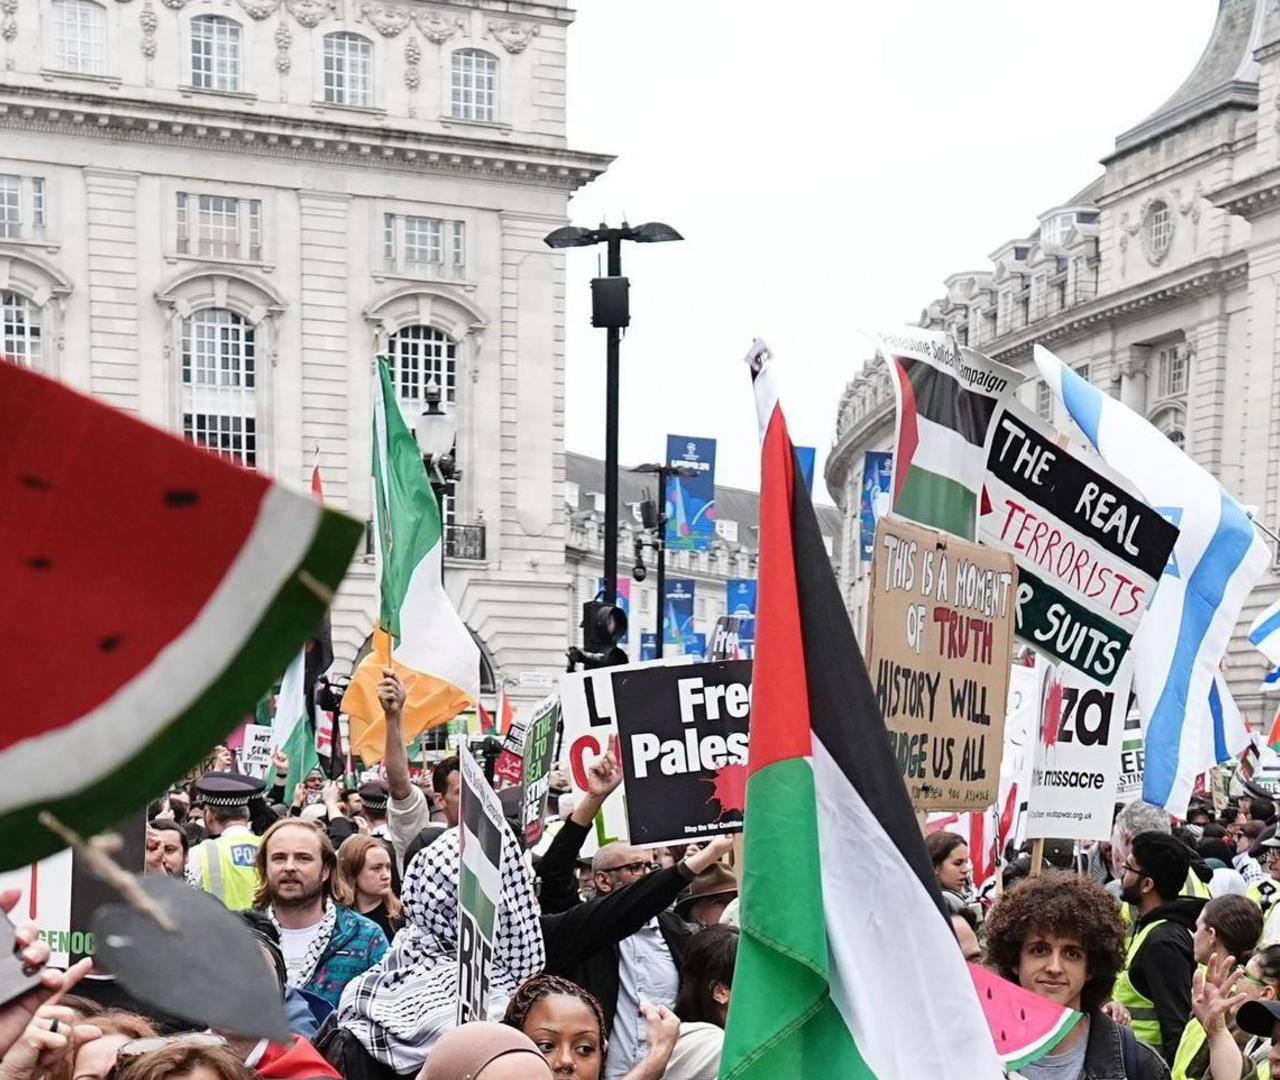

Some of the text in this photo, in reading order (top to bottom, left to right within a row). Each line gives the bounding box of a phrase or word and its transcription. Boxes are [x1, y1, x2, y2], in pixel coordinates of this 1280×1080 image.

[959, 362, 1008, 393] ampaign
[1000, 418, 1140, 557] THE REAL
[883, 534, 918, 592] THIS
[921, 549, 933, 596] IS
[936, 554, 948, 602] A
[954, 558, 1013, 619] MOMENT
[1000, 499, 1146, 617] TERRORISTS
[906, 603, 993, 665] OF TRUTH
[1034, 603, 1122, 676] SUITS
[677, 677, 753, 723] Fre
[876, 658, 990, 726] HISTORY WILL
[535, 712, 552, 740] THE
[630, 728, 750, 779] Pales
[932, 736, 954, 780] US
[960, 734, 987, 782] ALL
[1044, 769, 1105, 790] massacre
